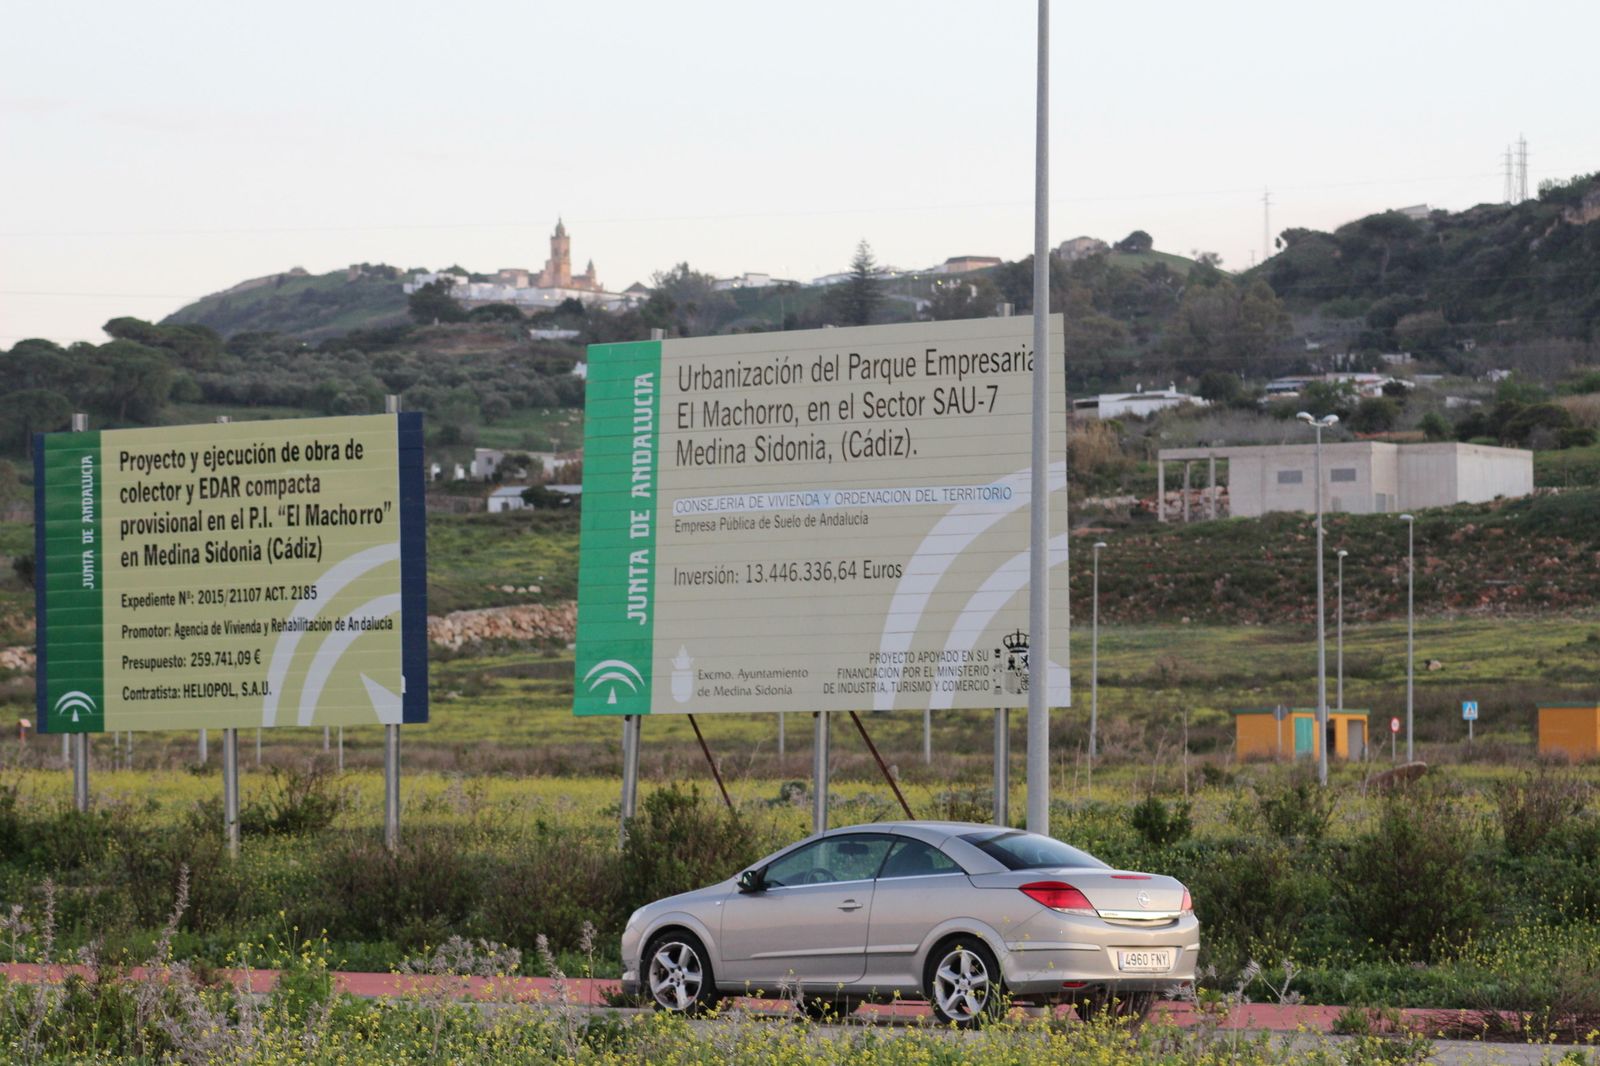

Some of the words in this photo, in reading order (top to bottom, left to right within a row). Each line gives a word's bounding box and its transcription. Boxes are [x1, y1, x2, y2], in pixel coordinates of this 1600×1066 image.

[678, 356, 802, 392] Urbanización
[811, 353, 840, 383] del
[848, 353, 917, 385] Parque
[925, 344, 1034, 382] Empresaria
[677, 401, 695, 429] El
[703, 397, 799, 428] Machorro,
[807, 400, 830, 423] en
[838, 392, 855, 420] el
[862, 391, 926, 420] Sector
[933, 385, 998, 416] SAU-7
[631, 372, 654, 499] ANDALUCIA
[676, 437, 747, 467] Medina
[754, 434, 833, 464] Sidonia,
[841, 427, 917, 462] (Cádiz).
[120, 448, 186, 475] Proyecto
[190, 453, 199, 474] y
[203, 441, 276, 471] ejecución
[280, 441, 300, 463] de
[304, 440, 340, 462] obra
[344, 438, 364, 460] de
[120, 480, 181, 504] colector
[186, 483, 195, 505] y
[200, 476, 240, 500] EDAR
[245, 474, 321, 499] compacta
[675, 496, 745, 513] CONSEJERIA
[749, 495, 764, 509] DE
[768, 493, 821, 507] VIVIENDA
[822, 492, 831, 505] Y
[834, 489, 911, 505] ORDENACION
[915, 489, 938, 503] DEL
[942, 486, 1012, 501] TERRITORIO
[120, 509, 202, 540] provisional
[207, 513, 226, 531] en
[231, 506, 245, 530] el
[248, 506, 273, 529] P.I.
[278, 503, 301, 528] “El
[305, 501, 391, 526] Machorro”
[630, 509, 651, 539] DE
[674, 518, 716, 535] Empresa
[719, 516, 755, 531] Pública
[759, 515, 771, 530] de
[774, 514, 801, 529] Suelo
[804, 514, 816, 528] de
[819, 511, 869, 527] Andalucía
[82, 528, 94, 544] DE
[120, 549, 139, 568] en
[143, 542, 200, 567] Medina
[204, 538, 262, 564] Sidonia
[266, 535, 322, 564] (Cádiz)
[82, 550, 95, 590] JUNTA
[673, 565, 739, 586] Inversión:
[746, 560, 857, 585] 13.446.336,64
[863, 559, 903, 580] Euros
[121, 592, 175, 611] Expediente
[198, 587, 262, 607] 2015/21107
[265, 586, 288, 601] ACT.
[291, 585, 317, 600] 2185
[627, 548, 649, 626] JUNTA
[122, 624, 171, 639] Promotor:
[174, 622, 208, 640] Agencia
[211, 621, 222, 635] de
[224, 619, 262, 634] Vivienda
[264, 621, 269, 636] y
[271, 616, 332, 633] Rehabilitación
[335, 617, 346, 631] de
[348, 615, 393, 632] Andalucía
[122, 655, 186, 672] Presupuesto:
[190, 650, 251, 669] 259.741,09
[254, 648, 261, 665] €
[869, 651, 916, 664] PROYECTO
[917, 650, 962, 663] APOYADO
[962, 650, 975, 662] EN
[977, 649, 989, 662] SU
[698, 669, 734, 681] Excmo.
[737, 668, 809, 682] Ayuntamiento
[902, 666, 922, 678] POR
[923, 666, 934, 678] EL
[937, 665, 989, 677] MINISTERIO
[122, 684, 181, 701] Contratista:
[183, 682, 239, 699] HELIOPOL,
[241, 681, 272, 697] S.A.U.
[697, 686, 711, 697] de
[713, 685, 752, 697] Medina
[755, 684, 793, 696] Sidonia
[823, 682, 835, 694] DE
[838, 680, 888, 694] INDUSTRIA,
[891, 681, 932, 693] TURISMO
[934, 680, 940, 692] Y
[942, 679, 990, 693] COMERCIO
[1125, 953, 1148, 966] 4960
[1151, 953, 1167, 966] FNY
